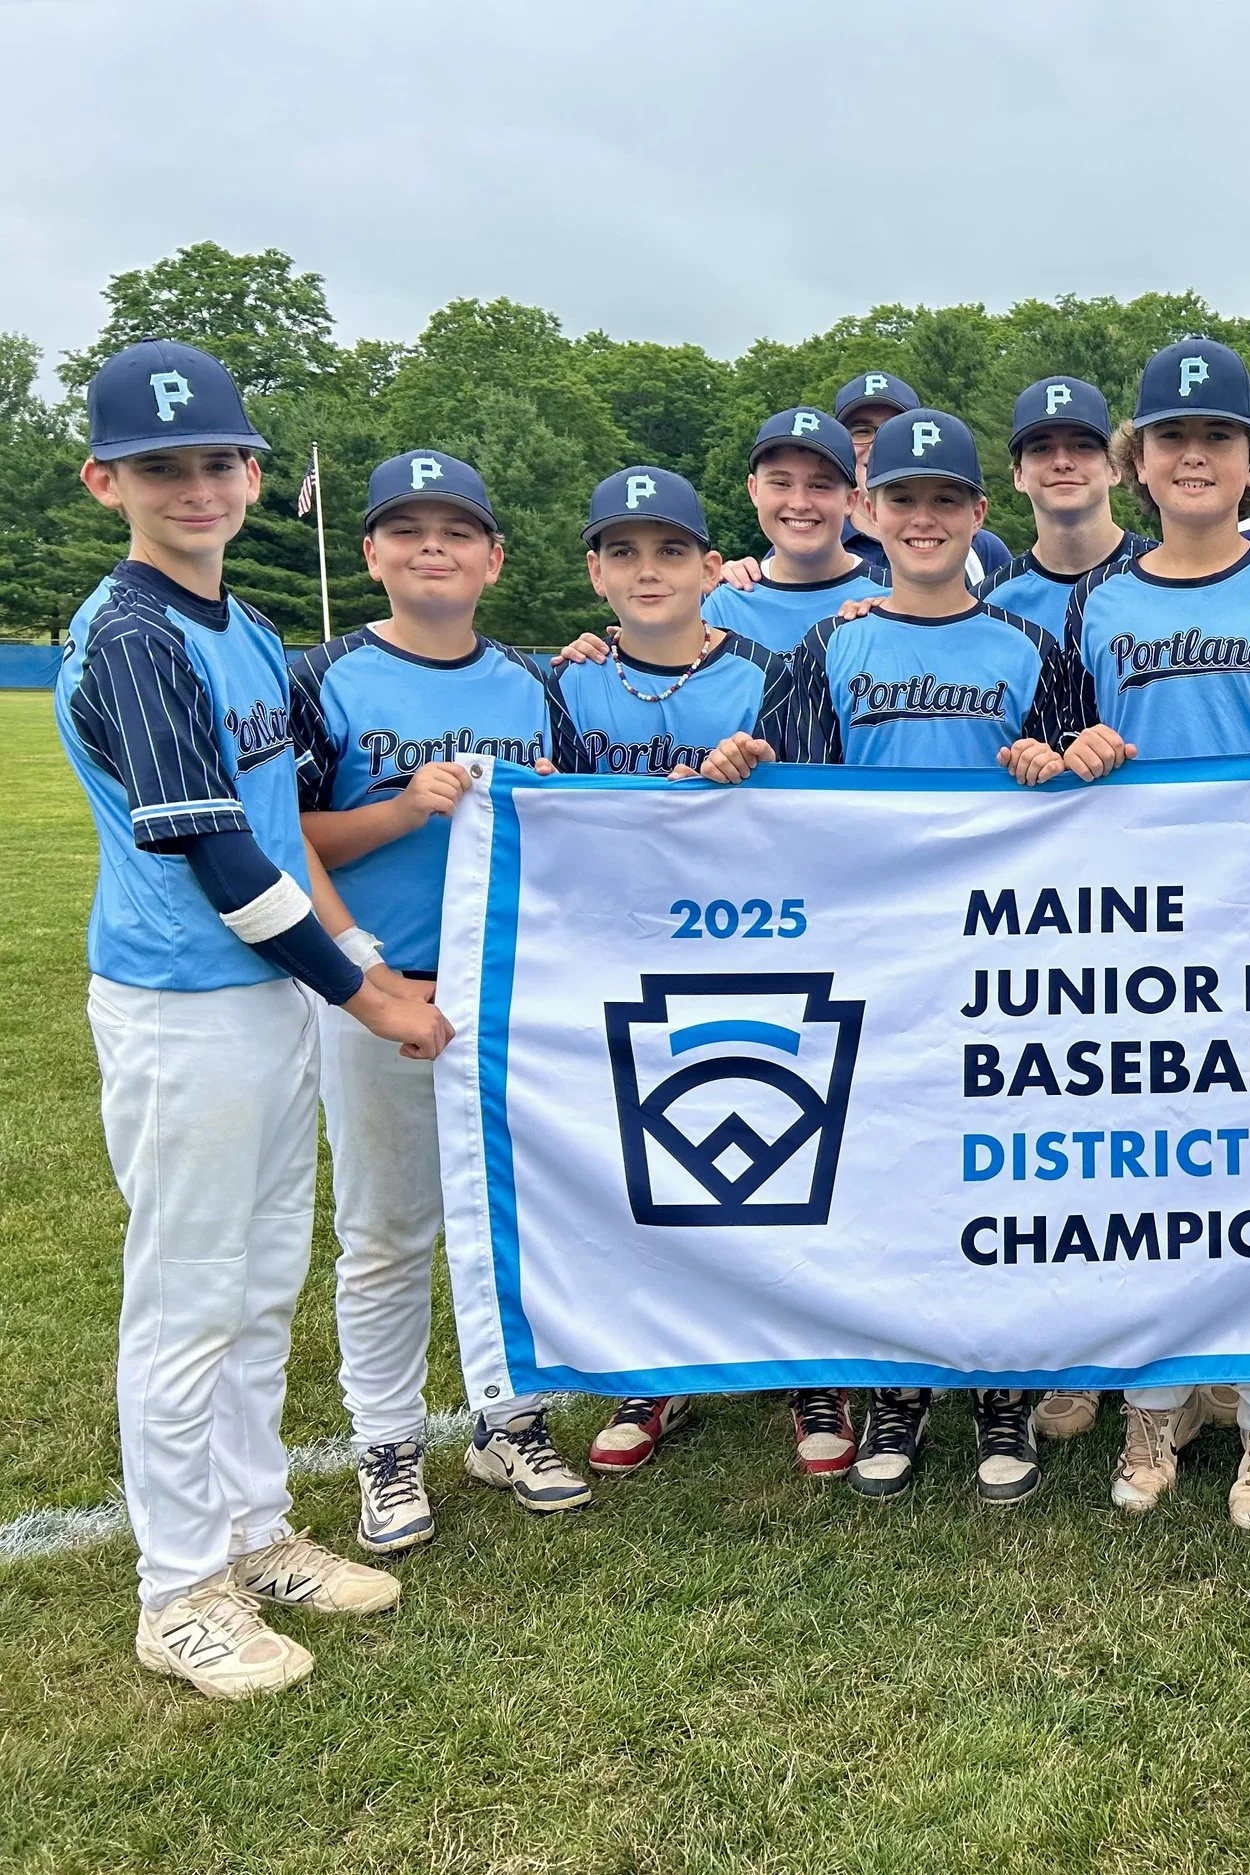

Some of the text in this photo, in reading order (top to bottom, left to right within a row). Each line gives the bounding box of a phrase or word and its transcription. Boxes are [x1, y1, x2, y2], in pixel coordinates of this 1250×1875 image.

[149, 369, 195, 422] P
[864, 374, 889, 396] P
[1179, 355, 1210, 397] P
[1046, 383, 1073, 415] P
[790, 412, 821, 437] P
[911, 420, 943, 457] P
[410, 456, 445, 490] P
[626, 474, 657, 510] P
[848, 671, 1008, 717] Portland
[669, 898, 808, 940] 2025
[962, 885, 1184, 937] MAINE
[960, 965, 1223, 1018] JUNIOR
[963, 1127, 1250, 1182] DISTRICT
